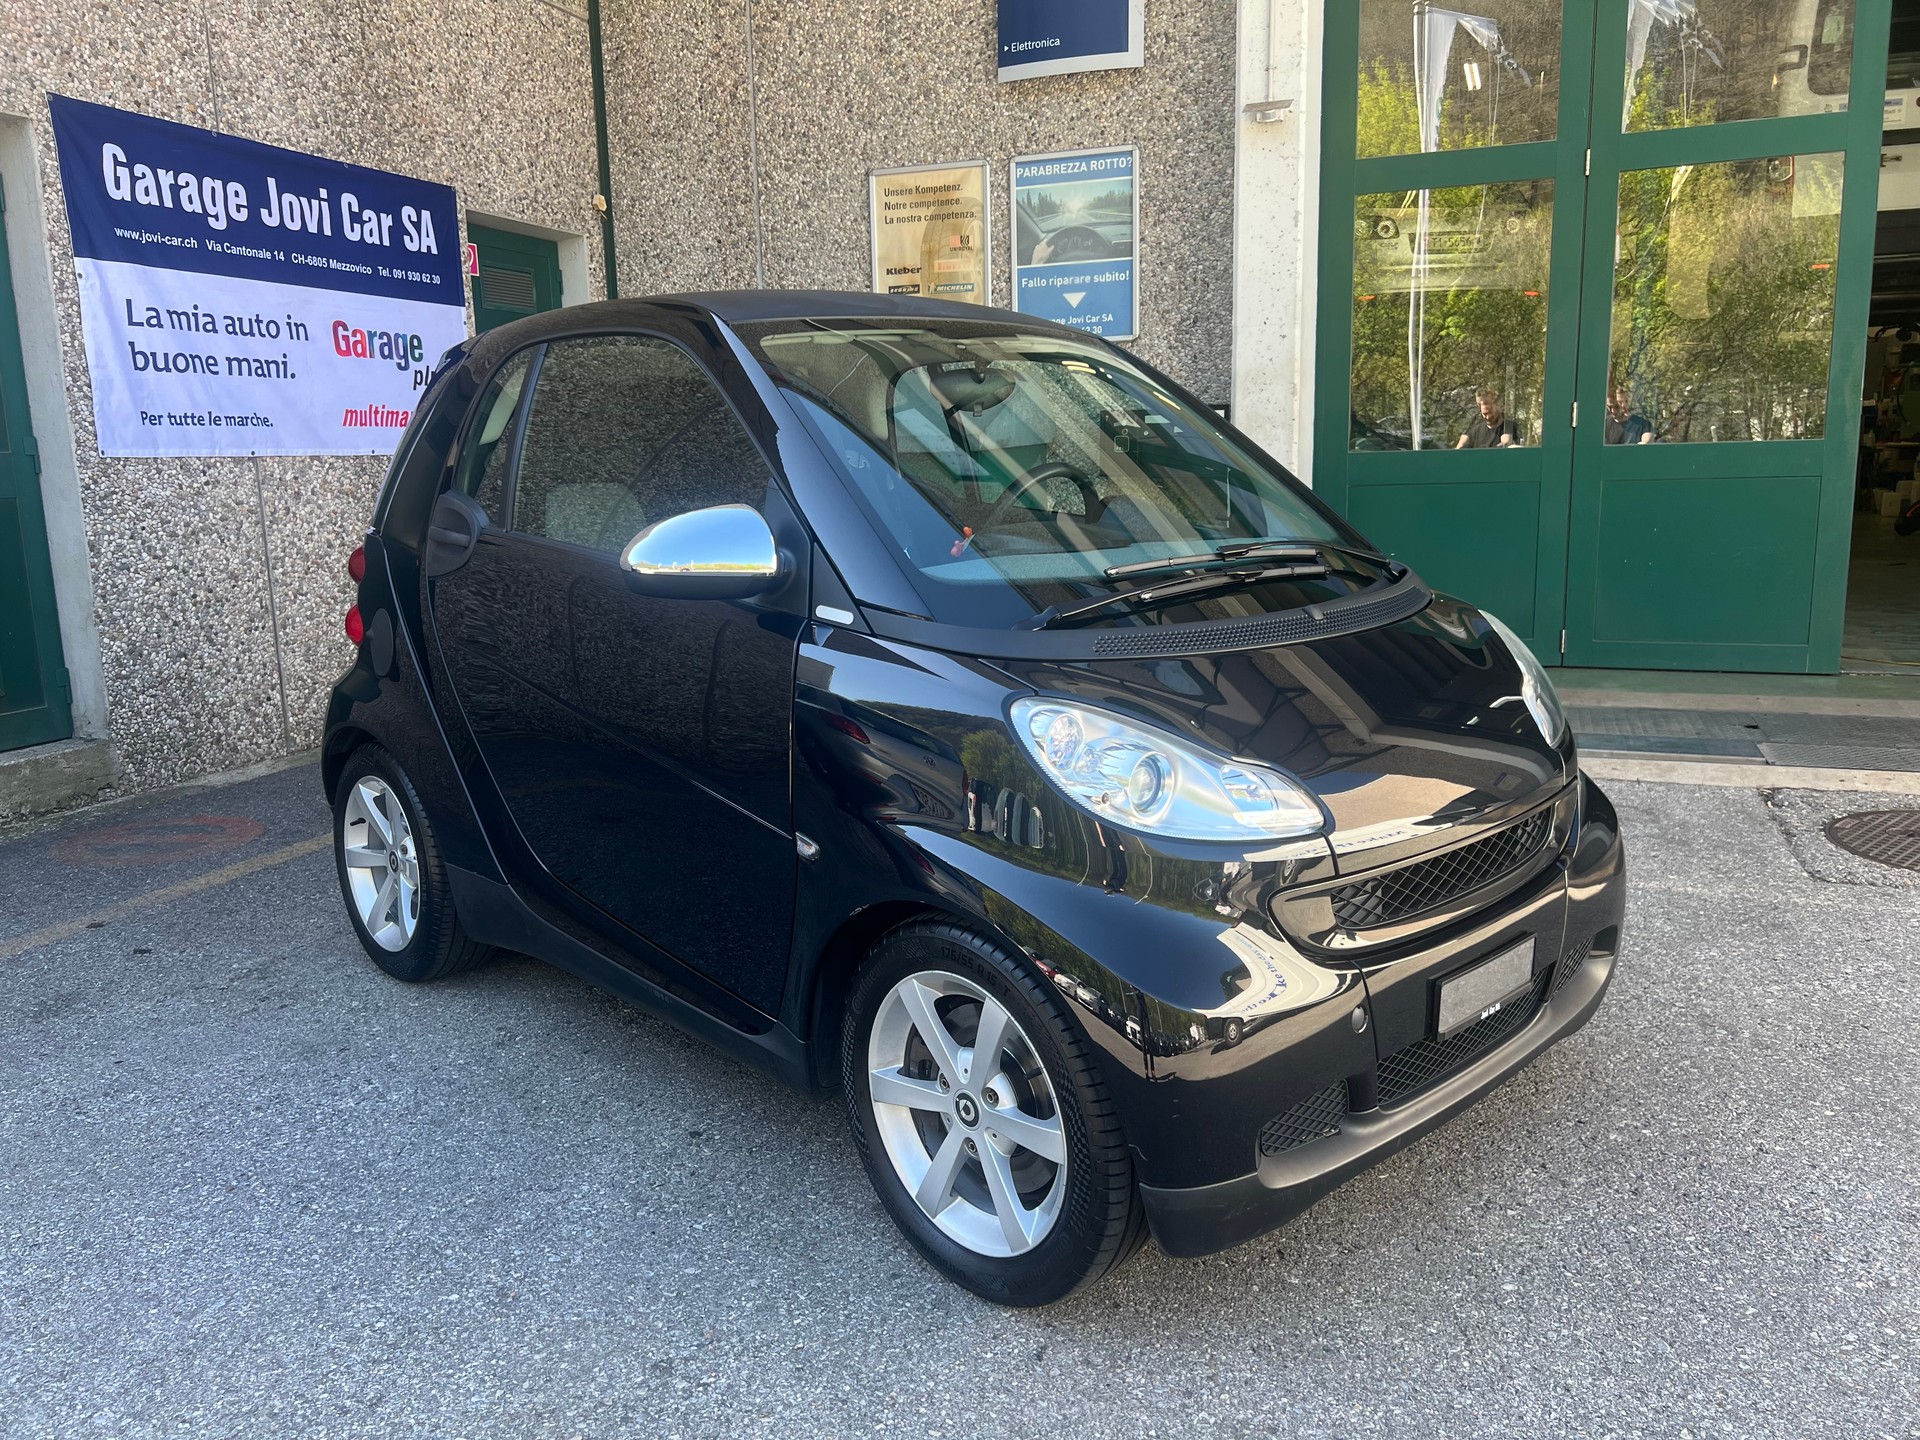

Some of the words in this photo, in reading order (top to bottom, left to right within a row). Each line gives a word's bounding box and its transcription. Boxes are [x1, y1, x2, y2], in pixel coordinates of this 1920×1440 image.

[1011, 37, 1060, 53] Elettronica
[1016, 161, 1088, 178] PARABREZZA
[1090, 156, 1133, 171] ROTTO?
[102, 142, 248, 231] Garage
[259, 176, 332, 237] Jovi
[340, 192, 393, 247] Car
[401, 205, 438, 255] SA
[884, 187, 913, 197] Unsere
[915, 183, 963, 196] Kompetenz.
[884, 201, 907, 211] Notre
[909, 197, 963, 210] compétence.
[884, 215, 894, 225] La
[896, 214, 922, 224] nostra
[924, 210, 977, 222] competenza.
[114, 227, 198, 248] www.jovi-car.ch
[205, 239, 222, 252] Via
[223, 242, 272, 260] Cantonale
[273, 250, 285, 262] 14
[291, 253, 328, 268] CH-6805
[329, 259, 372, 275] Mezzovico
[377, 266, 392, 278] Tel.
[393, 268, 406, 280] 091
[407, 271, 421, 283] 930
[422, 273, 431, 283] 62
[432, 275, 441, 285] 30
[886, 266, 922, 276] Kleber
[1021, 277, 1047, 288] Fallo
[1049, 274, 1091, 288] riparare
[1093, 270, 1130, 283] subito!
[936, 284, 973, 292] MICHELIN
[125, 298, 164, 329] La
[166, 304, 218, 334] mia
[223, 313, 281, 340] auto
[286, 314, 309, 342] in
[1067, 315, 1084, 325] Jovi
[1086, 314, 1100, 323] Car
[1102, 313, 1113, 322] SA
[1092, 325, 1102, 334] 30
[332, 320, 424, 371] Garage
[128, 340, 219, 375] buone
[225, 352, 296, 379] mani.
[413, 365, 436, 391] pl
[140, 410, 164, 426] Per
[167, 412, 205, 427] tutte
[208, 410, 222, 426] le
[224, 412, 274, 427] marche.
[342, 404, 413, 428] multima
[940, 946, 974, 969] 175/55
